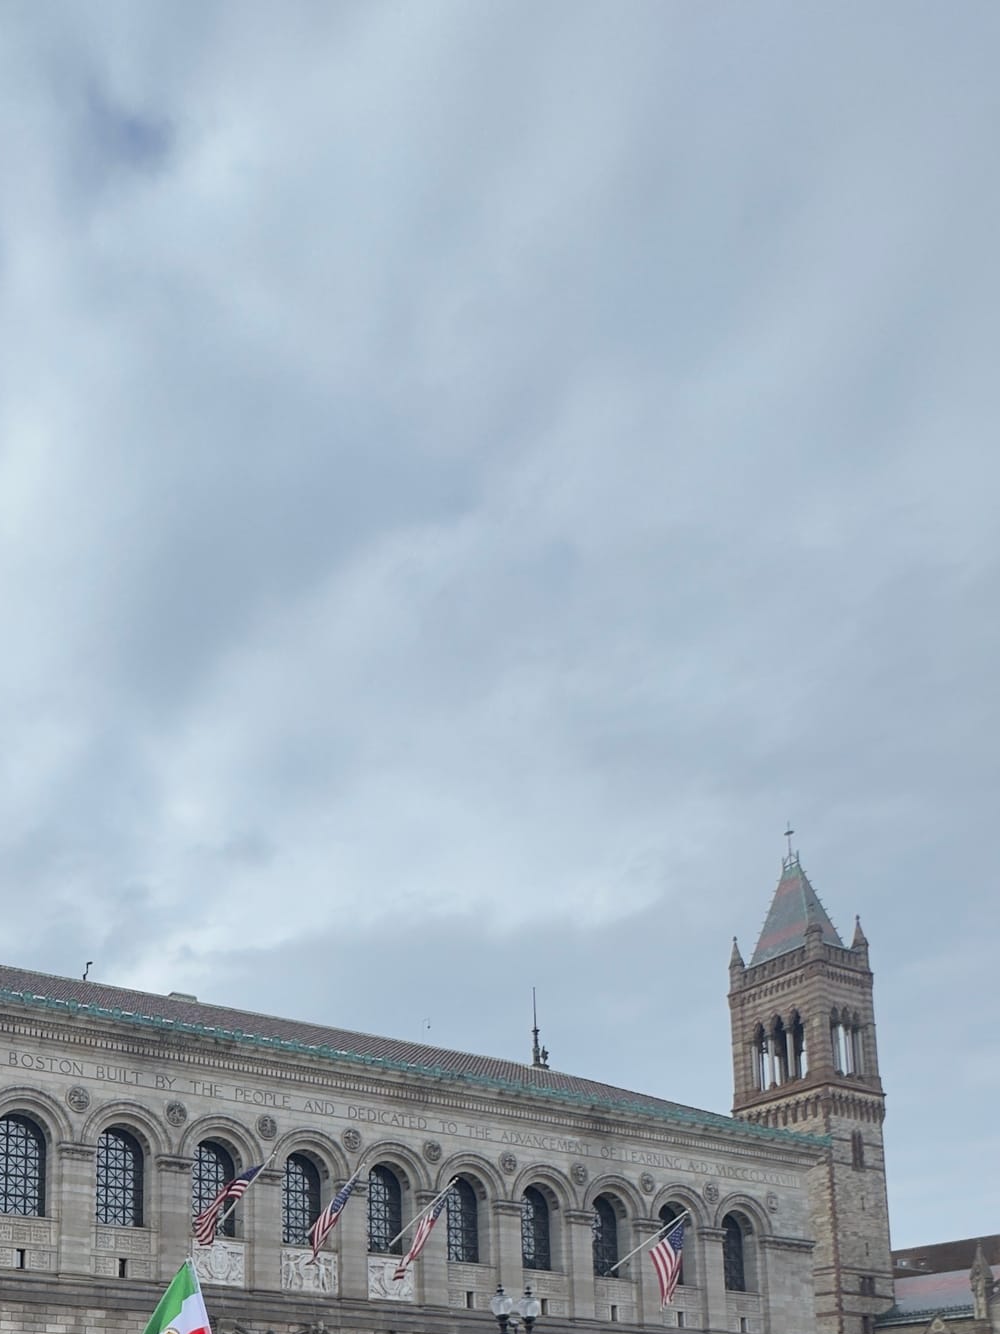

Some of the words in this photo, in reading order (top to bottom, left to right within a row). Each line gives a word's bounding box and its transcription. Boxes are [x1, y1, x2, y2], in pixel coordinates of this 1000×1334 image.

[8, 1051, 84, 1075] BOSTON
[96, 1065, 143, 1085] BUILT
[155, 1075, 177, 1089] BY
[190, 1080, 223, 1098] THE
[235, 1087, 291, 1108] PEOPLE
[303, 1100, 335, 1116] AND
[347, 1106, 428, 1129] DEDICATED
[440, 1121, 458, 1134] TO
[466, 1125, 491, 1139] THE
[501, 1131, 592, 1155] ADVANCEMENT
[601, 1146, 616, 1158] OF
[625, 1151, 682, 1170] LEARNING
